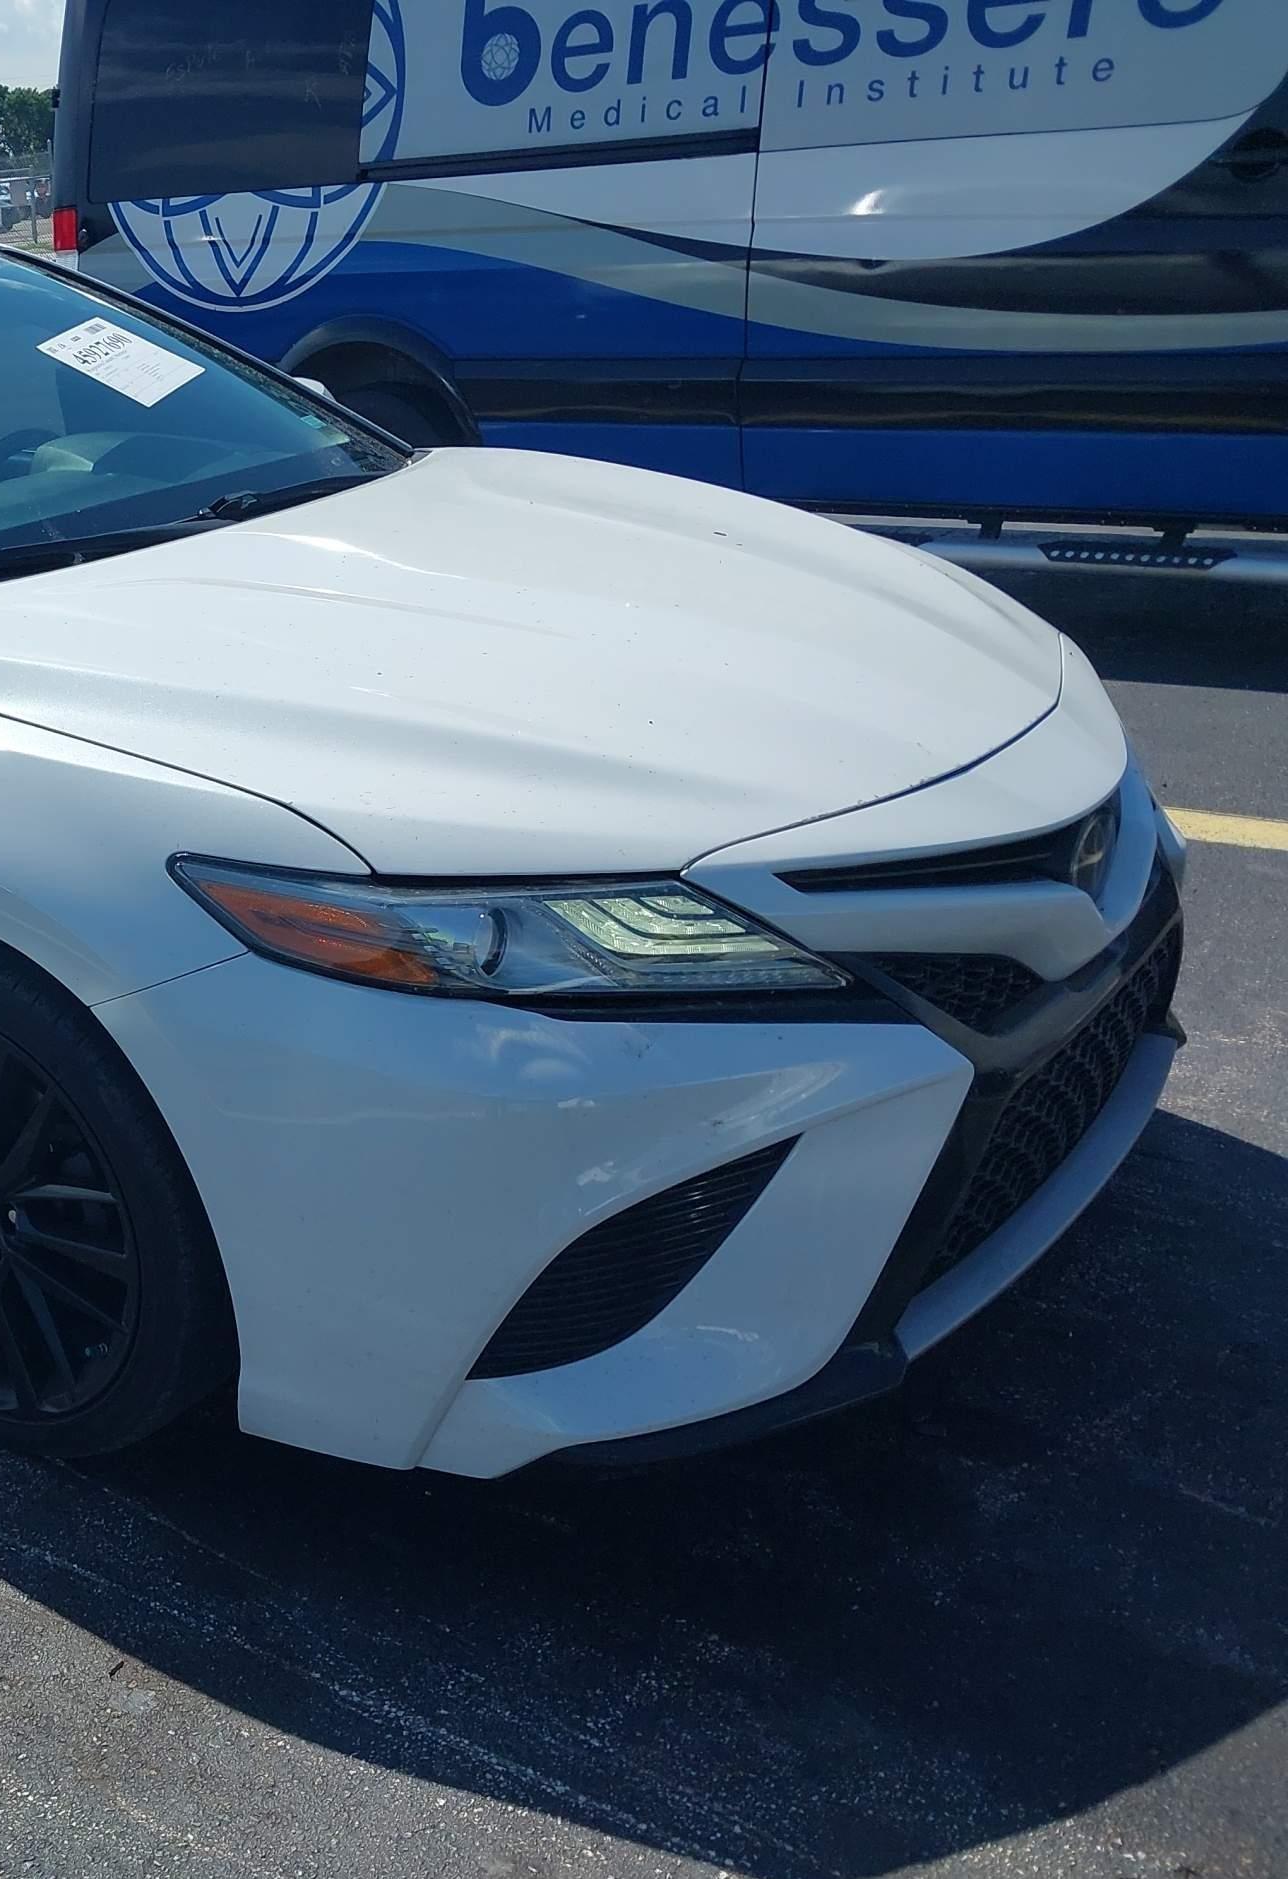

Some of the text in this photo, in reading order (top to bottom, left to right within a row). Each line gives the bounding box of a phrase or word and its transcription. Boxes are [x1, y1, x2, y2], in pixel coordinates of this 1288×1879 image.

[528, 56, 1116, 134] Medical Institute
[72, 332, 133, 366] 45927690
